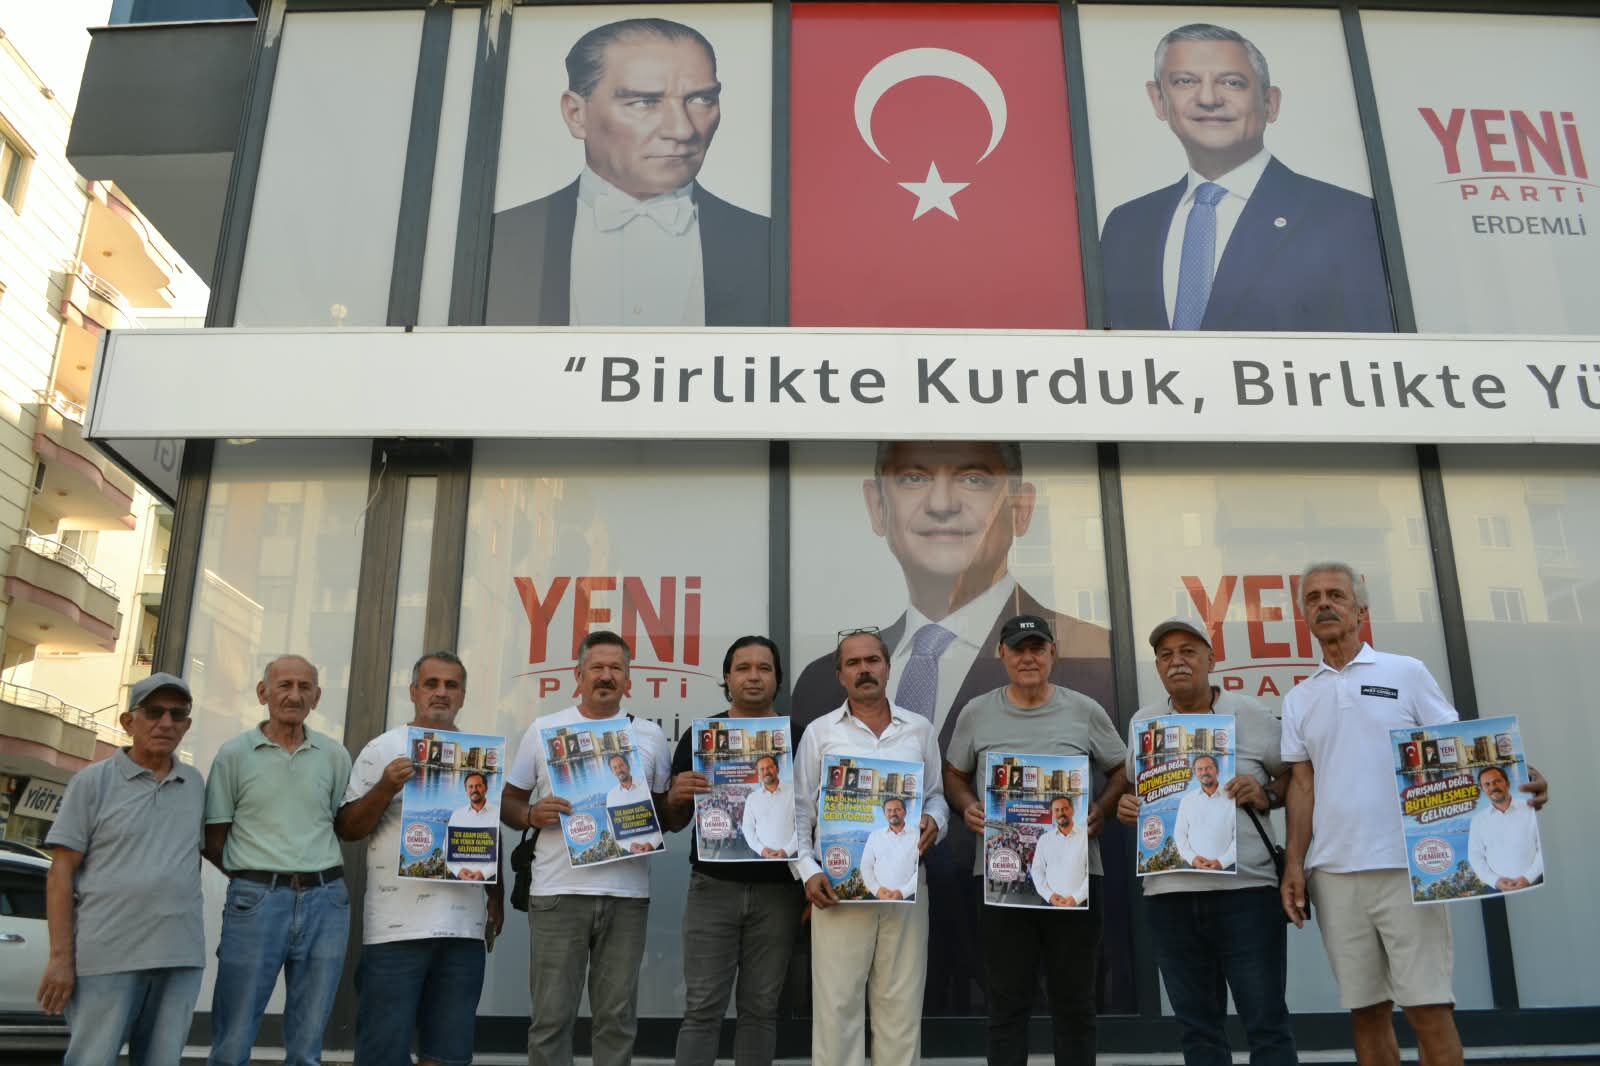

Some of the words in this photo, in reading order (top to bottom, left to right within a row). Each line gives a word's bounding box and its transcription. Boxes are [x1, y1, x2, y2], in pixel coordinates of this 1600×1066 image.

[1472, 213, 1587, 236] ERDEMLİ
[917, 358, 1205, 414] Kurduk,
[1232, 360, 1507, 410] Birlikte
[1405, 785, 1478, 813] BÜTÜNLEŞMEYE
[1406, 781, 1447, 799] AYRIŞMAYA
[1420, 800, 1473, 823] GELİYORUZ!
